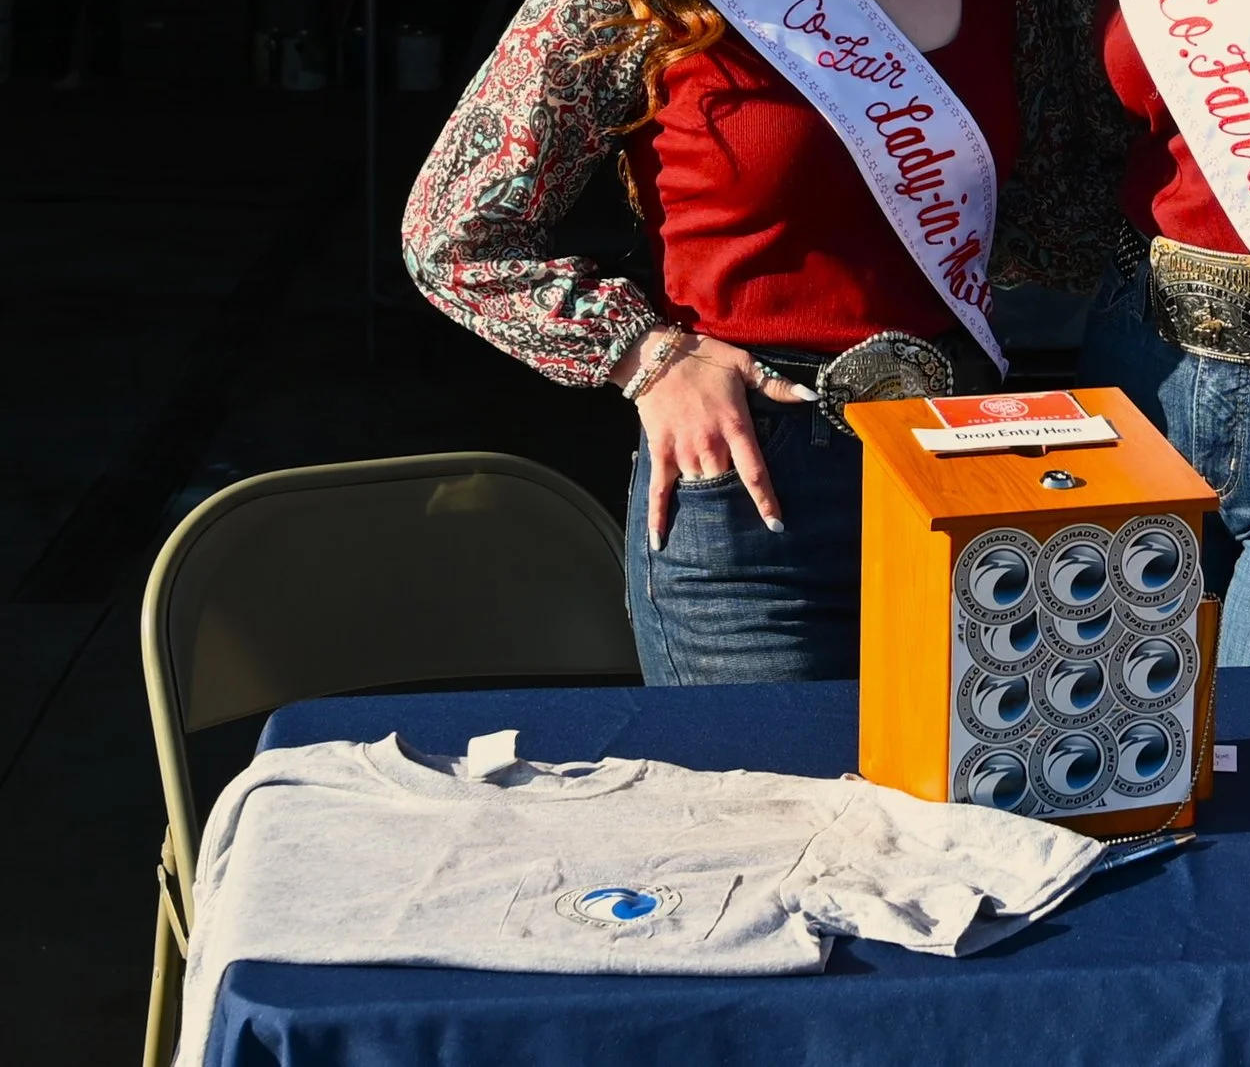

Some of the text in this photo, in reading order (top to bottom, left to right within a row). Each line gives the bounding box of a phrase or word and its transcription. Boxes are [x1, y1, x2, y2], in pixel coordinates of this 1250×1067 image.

[817, 34, 907, 90] Fair
[956, 424, 1082, 442] Drop Entry Here
[962, 535, 1017, 567] COLORADO
[1044, 530, 1099, 560] COLORADO
[1119, 518, 1192, 579] COLORADO AIR AND
[1040, 581, 1097, 616] SPACE PORT
[1112, 565, 1167, 603] SPACE PORT
[961, 589, 1022, 620] SPACE PORT
[1185, 648, 1193, 673] AND
[1116, 683, 1177, 709] SPACE PORT
